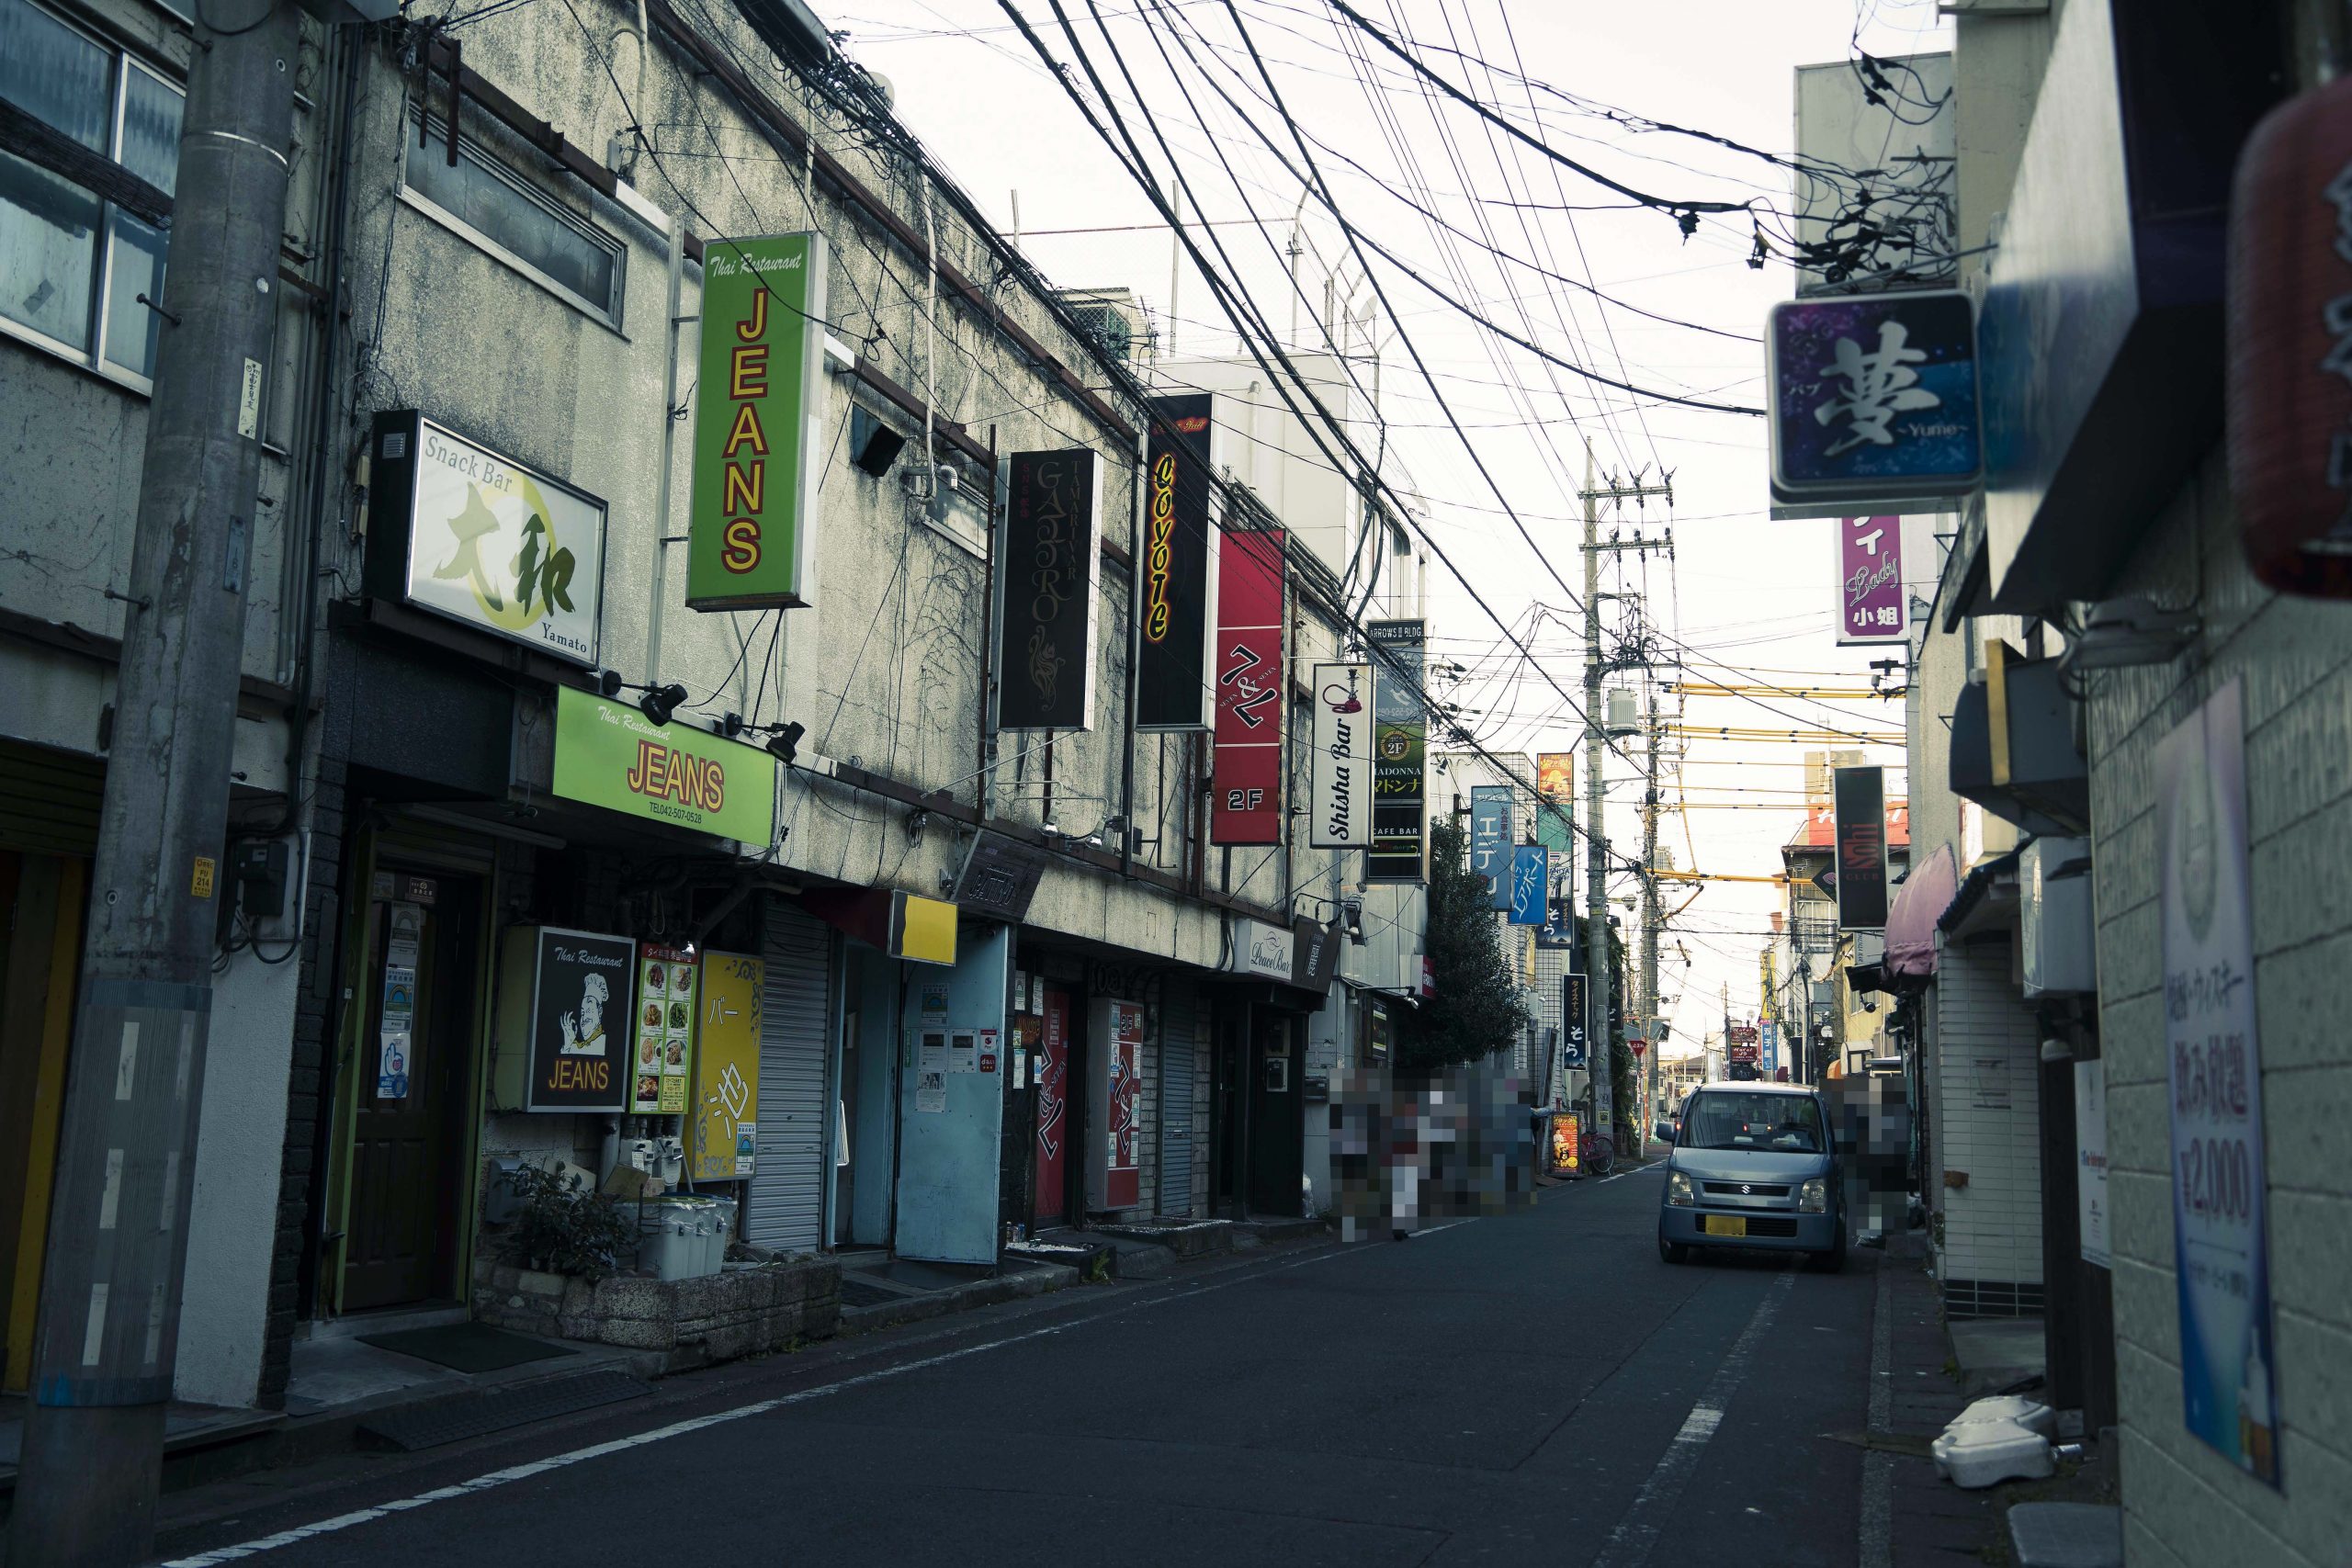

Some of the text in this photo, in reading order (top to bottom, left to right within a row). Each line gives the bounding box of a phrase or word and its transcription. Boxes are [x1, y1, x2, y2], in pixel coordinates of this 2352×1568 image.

[710, 251, 802, 277] Thai Restaurant
[1814, 321, 1941, 457] 夢
[721, 288, 770, 575] JEANS
[424, 434, 514, 494] Snack Bar
[432, 480, 577, 620] 大和
[1147, 454, 1174, 641] COYOTE
[1845, 551, 1899, 607] Lady
[1404, 626, 1422, 637] BLDG
[1853, 606, 1900, 626] 小姐
[542, 622, 589, 654] Yamato
[1258, 666, 1277, 682] SEVEN
[598, 705, 672, 741] Thai Restaurant
[1387, 742, 1405, 754] 2F
[628, 739, 724, 813] JEANS
[1329, 718, 1351, 841] Shisha Bar
[650, 801, 703, 824] TEL042-507-0528
[1228, 789, 1262, 811] 2F
[197, 876, 209, 887] 214
[554, 947, 624, 968] Thai Restaurant
[708, 996, 738, 1024] バー
[548, 1058, 610, 1091] JEANS
